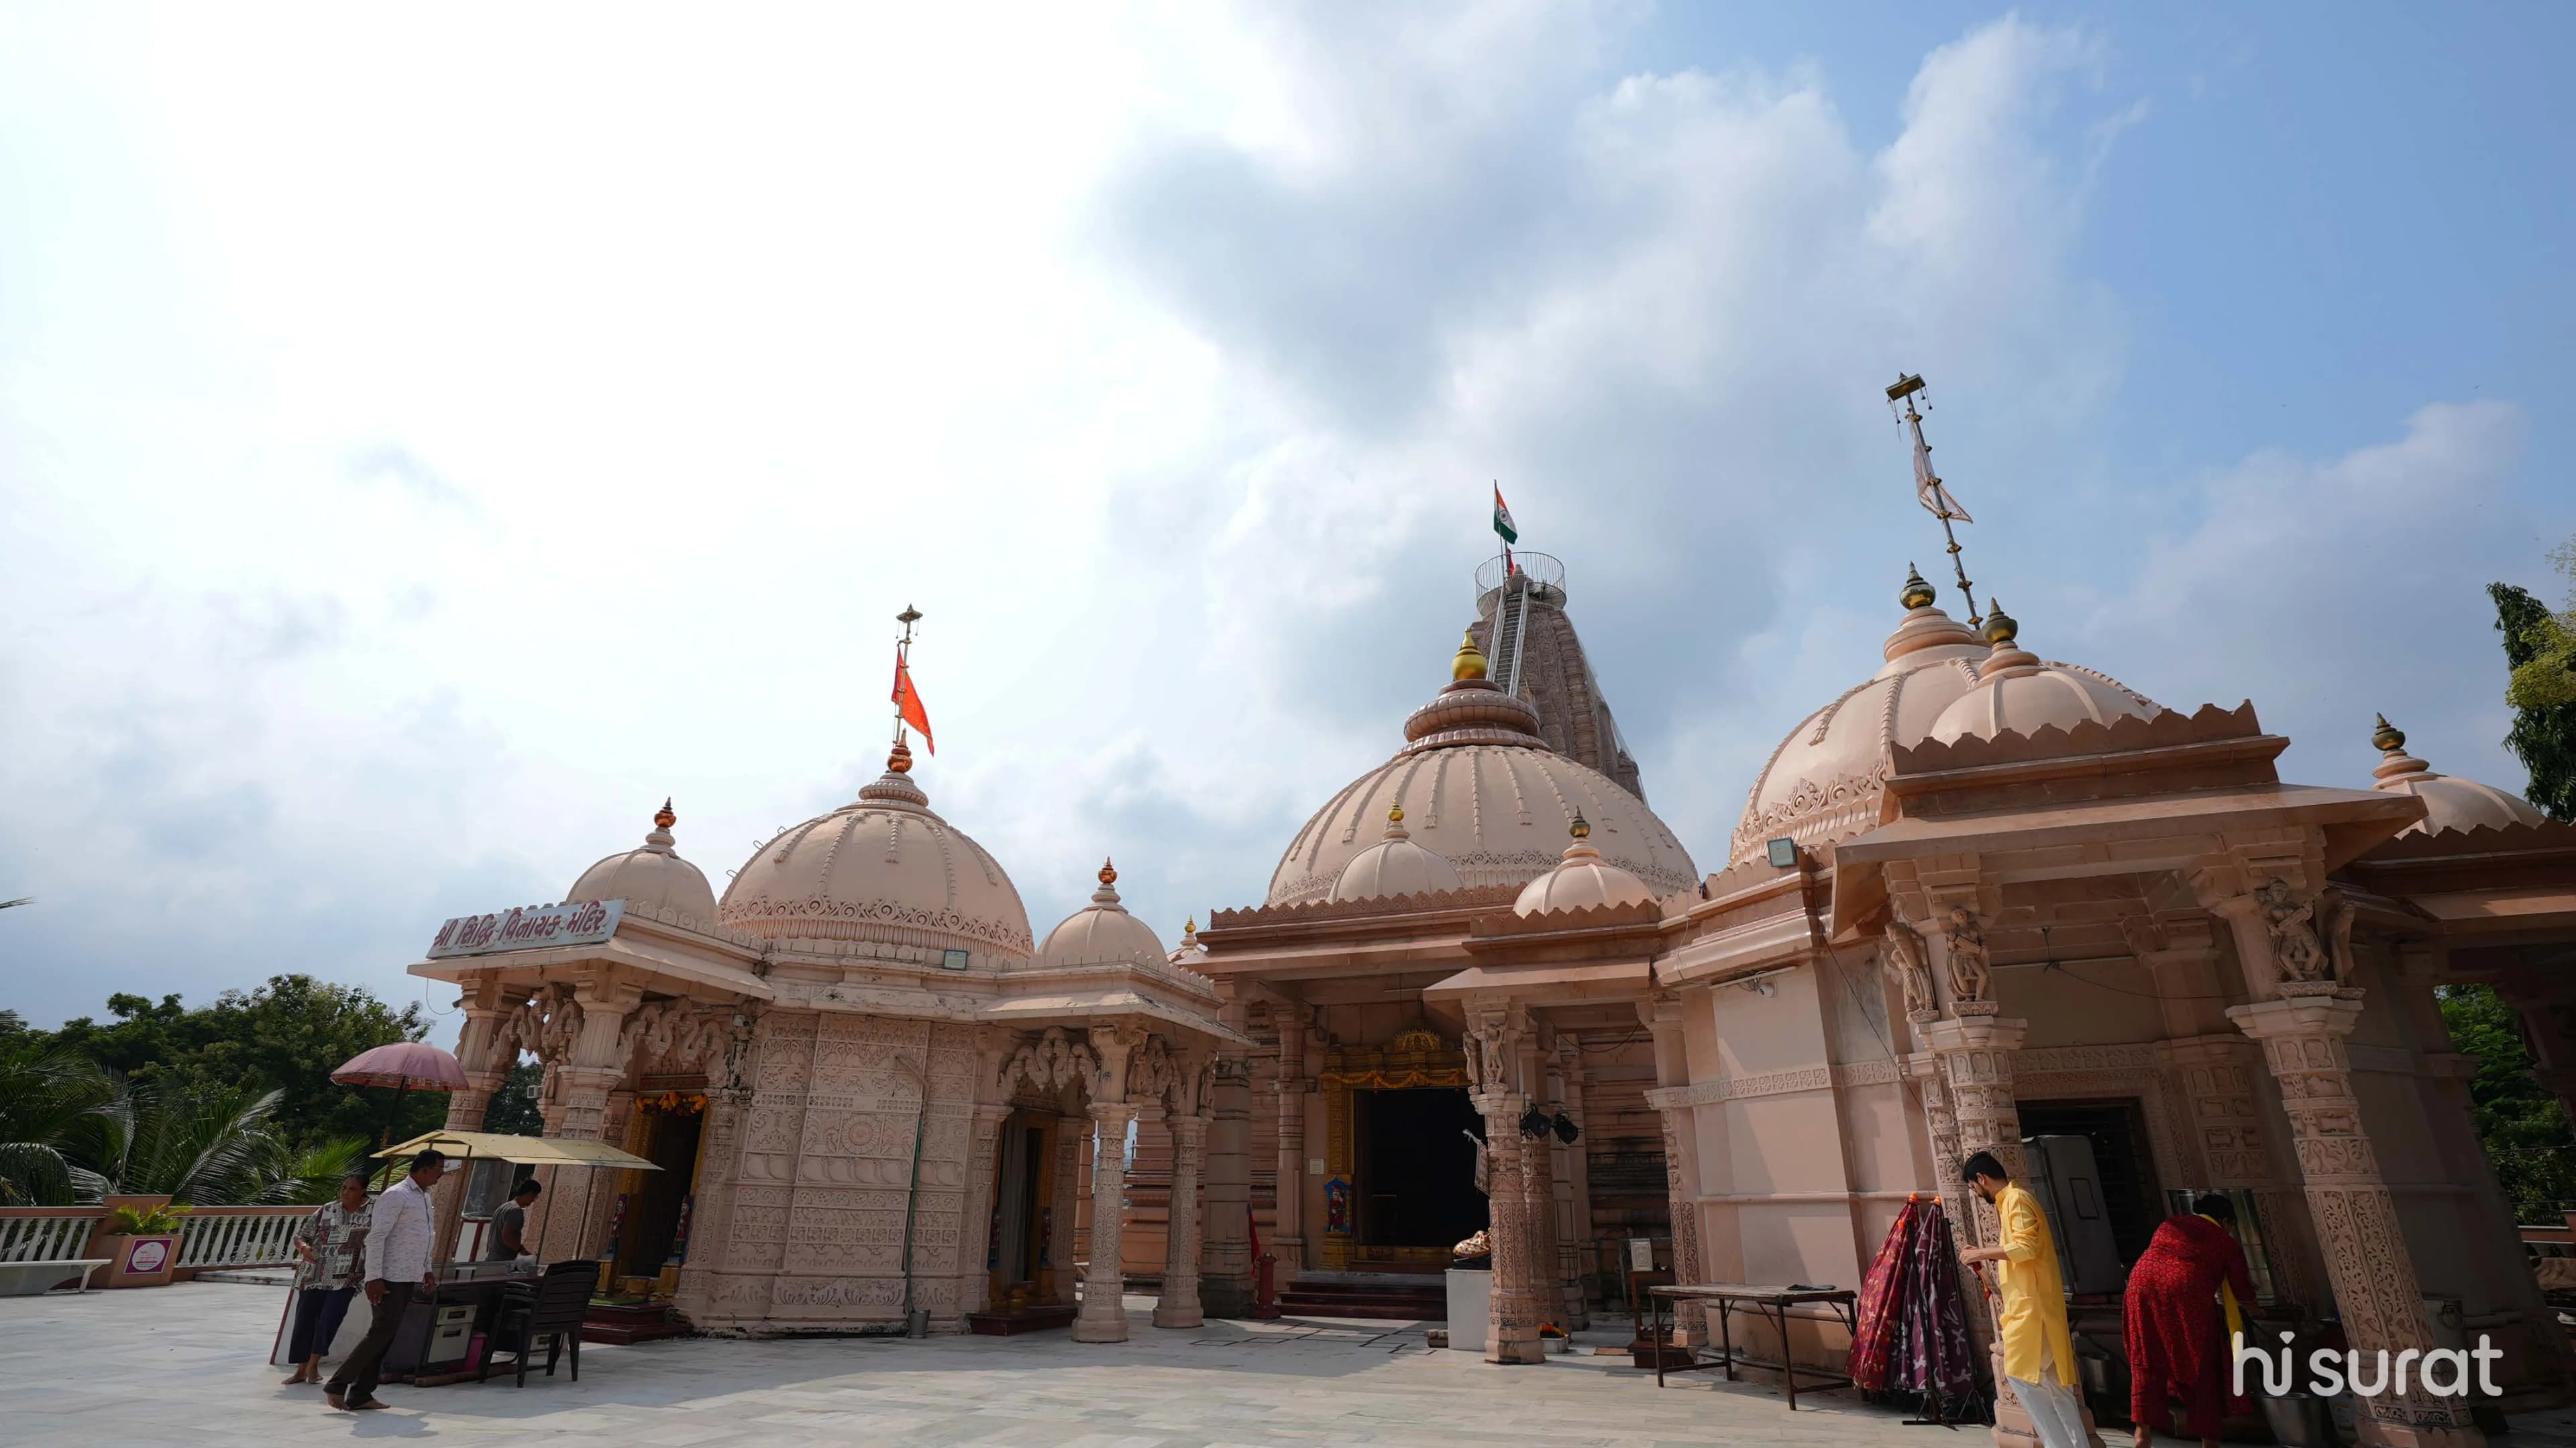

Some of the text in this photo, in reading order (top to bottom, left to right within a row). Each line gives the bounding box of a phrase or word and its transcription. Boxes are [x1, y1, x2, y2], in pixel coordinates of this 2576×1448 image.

[434, 918, 459, 946] શ્રી
[498, 910, 562, 941] વિનાયક
[566, 900, 607, 934] મંદિર
